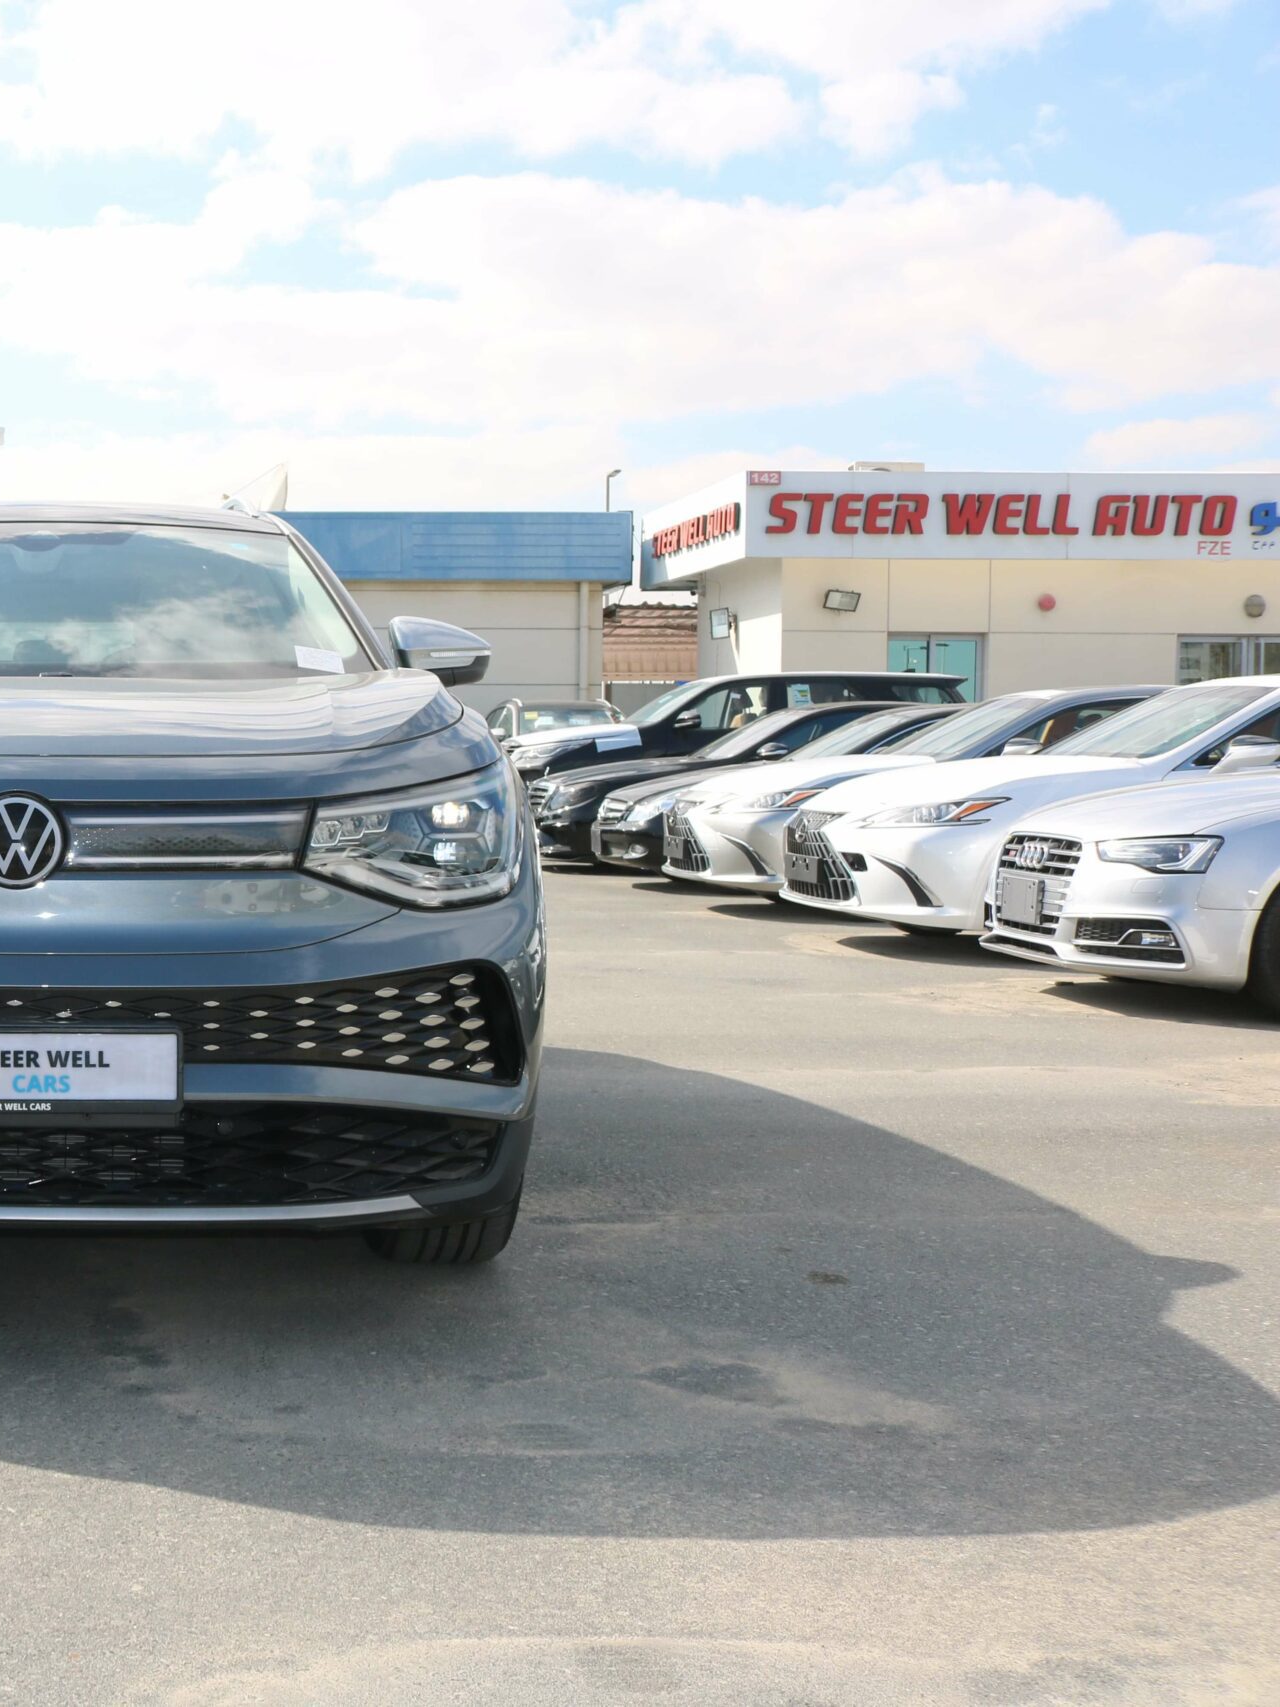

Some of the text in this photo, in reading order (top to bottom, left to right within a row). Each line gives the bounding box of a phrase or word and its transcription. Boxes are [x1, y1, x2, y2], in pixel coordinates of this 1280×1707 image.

[751, 472, 779, 484] 142
[765, 492, 1238, 537] STEER WELL AUTO
[651, 502, 741, 559] STEER WELL AUTO
[1196, 540, 1232, 556] FZE
[46, 1050, 110, 1068] WELL
[12, 1074, 71, 1093] CARS
[4, 1102, 28, 1111] WELL
[29, 1102, 52, 1111] CARS
